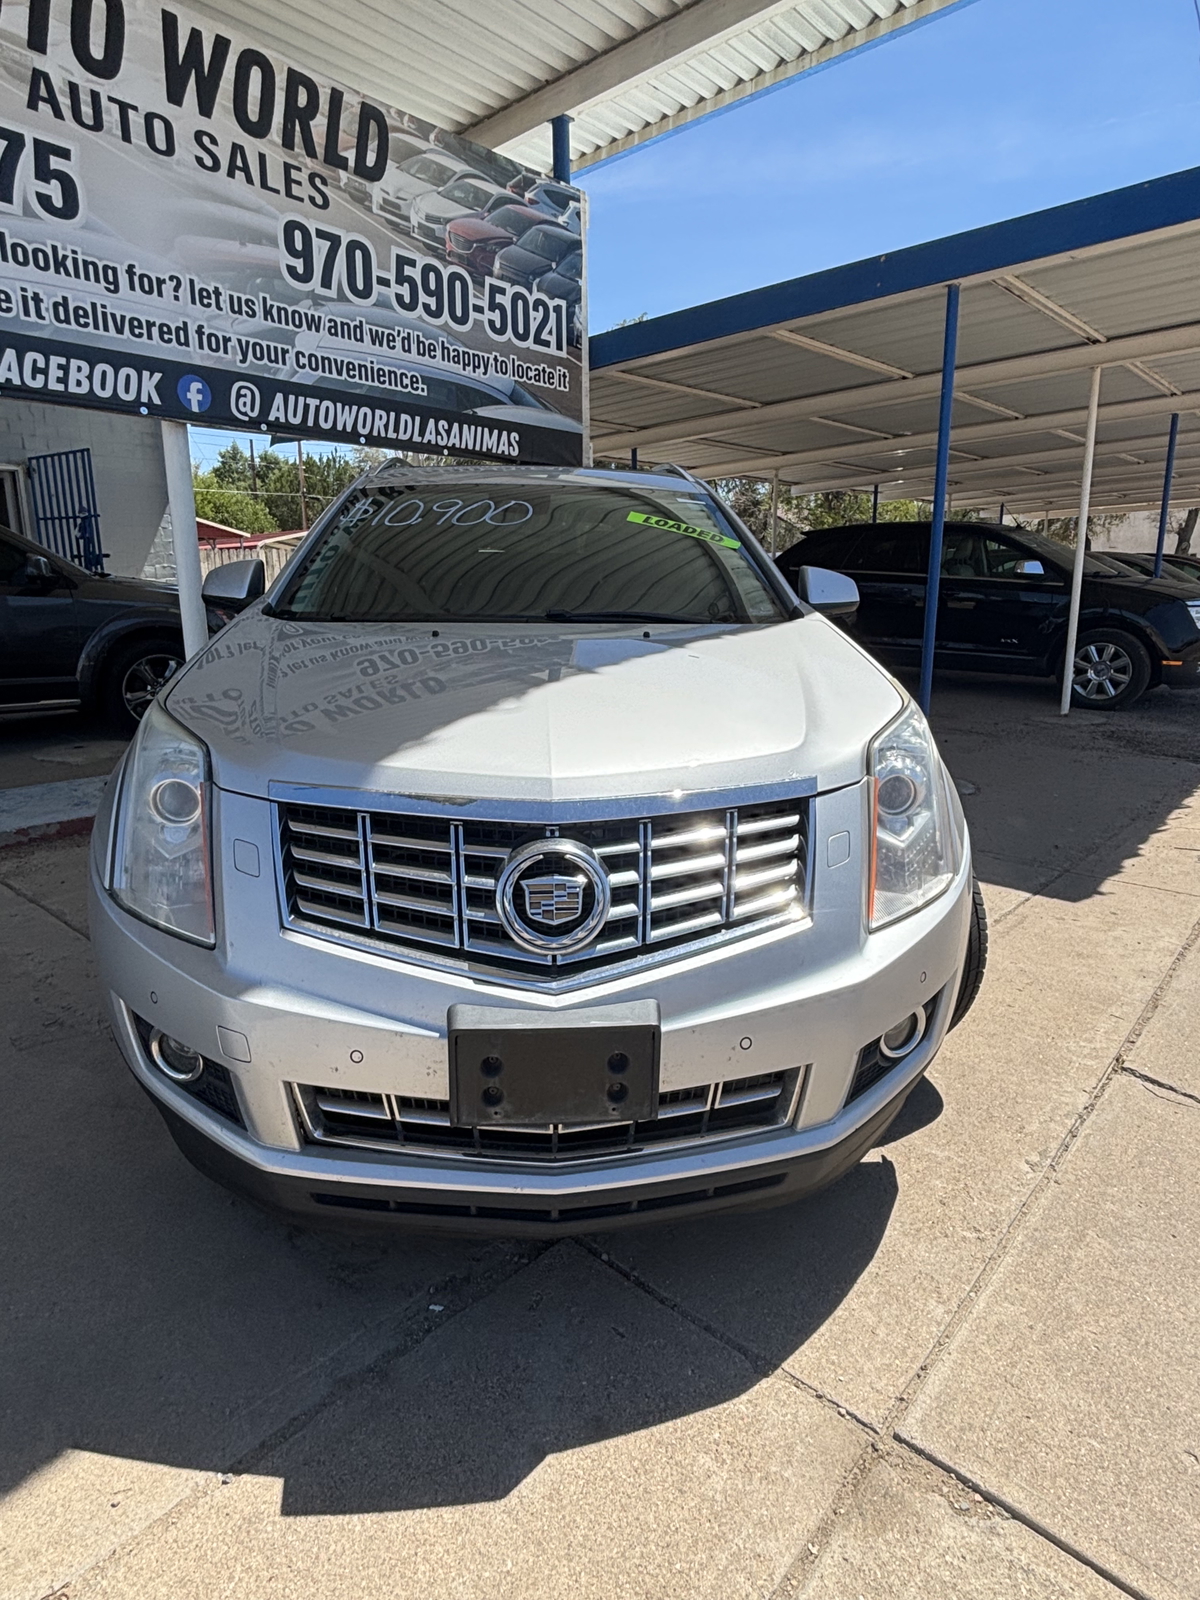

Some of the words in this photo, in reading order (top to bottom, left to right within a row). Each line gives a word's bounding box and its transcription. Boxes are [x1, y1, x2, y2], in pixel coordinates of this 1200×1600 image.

[26, 67, 176, 158] AUTO
[194, 130, 331, 211] SALES
[162, 8, 389, 183] WORLD
[0, 231, 120, 294] looking
[125, 263, 182, 302] for?
[189, 278, 223, 312] let
[229, 293, 257, 319] us
[262, 297, 322, 334] know
[327, 318, 364, 345] and
[368, 328, 412, 354] we'd
[416, 335, 437, 360] be
[441, 341, 490, 376] happy
[493, 354, 508, 375] to
[512, 358, 555, 386] locate
[557, 372, 567, 389] it
[20, 287, 46, 321] it
[52, 296, 190, 348] delivered
[195, 324, 232, 355] for
[237, 338, 289, 364] your
[295, 350, 427, 394] convenience.
[283, 220, 564, 352] 970-590-5021
[268, 392, 520, 457] AUTOWORLDLASANIMAS
[641, 515, 725, 544] LOADED
